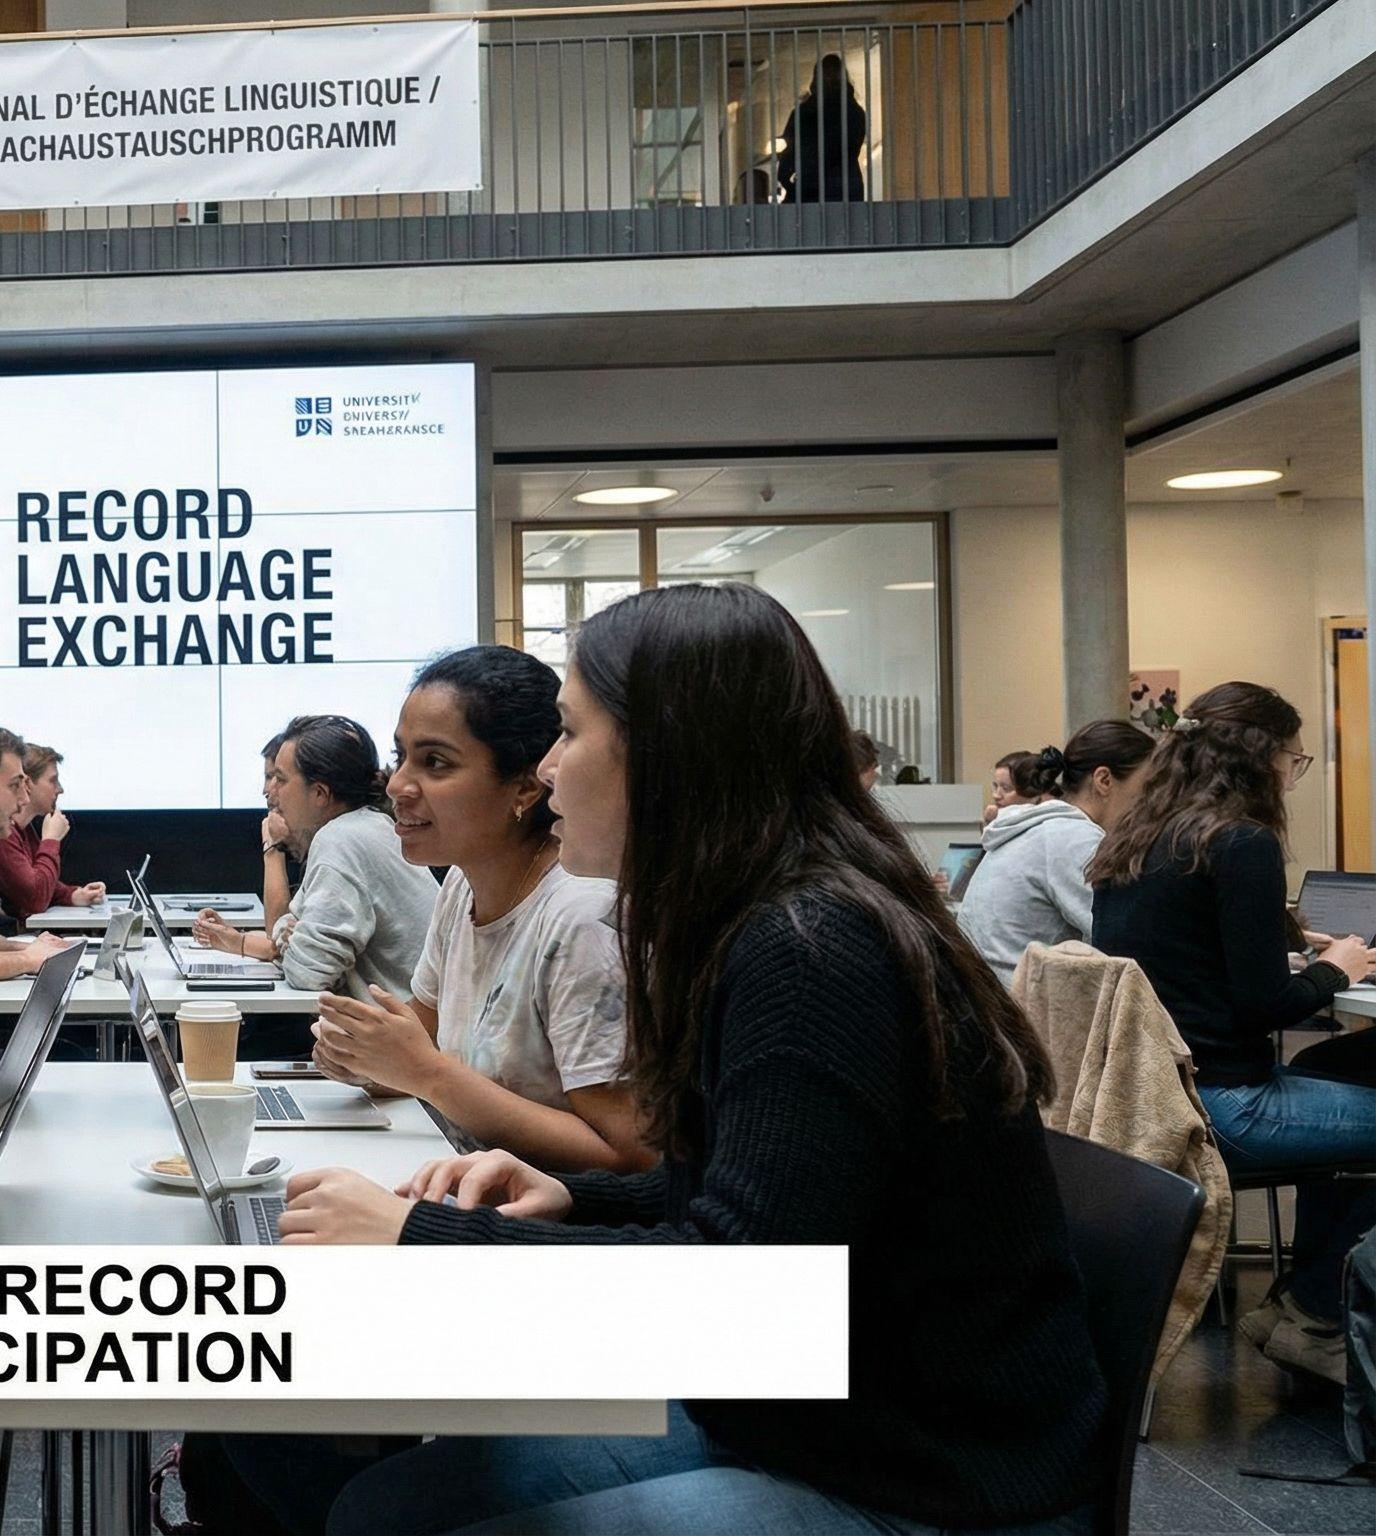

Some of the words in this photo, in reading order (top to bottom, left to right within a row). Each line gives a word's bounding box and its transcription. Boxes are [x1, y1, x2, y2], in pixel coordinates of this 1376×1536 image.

[224, 76, 420, 111] LINGUISTIQUE
[429, 75, 441, 104] /
[17, 488, 253, 543] RECORD
[18, 549, 333, 605] LANGUAGE
[18, 612, 334, 668] EXCHANGE
